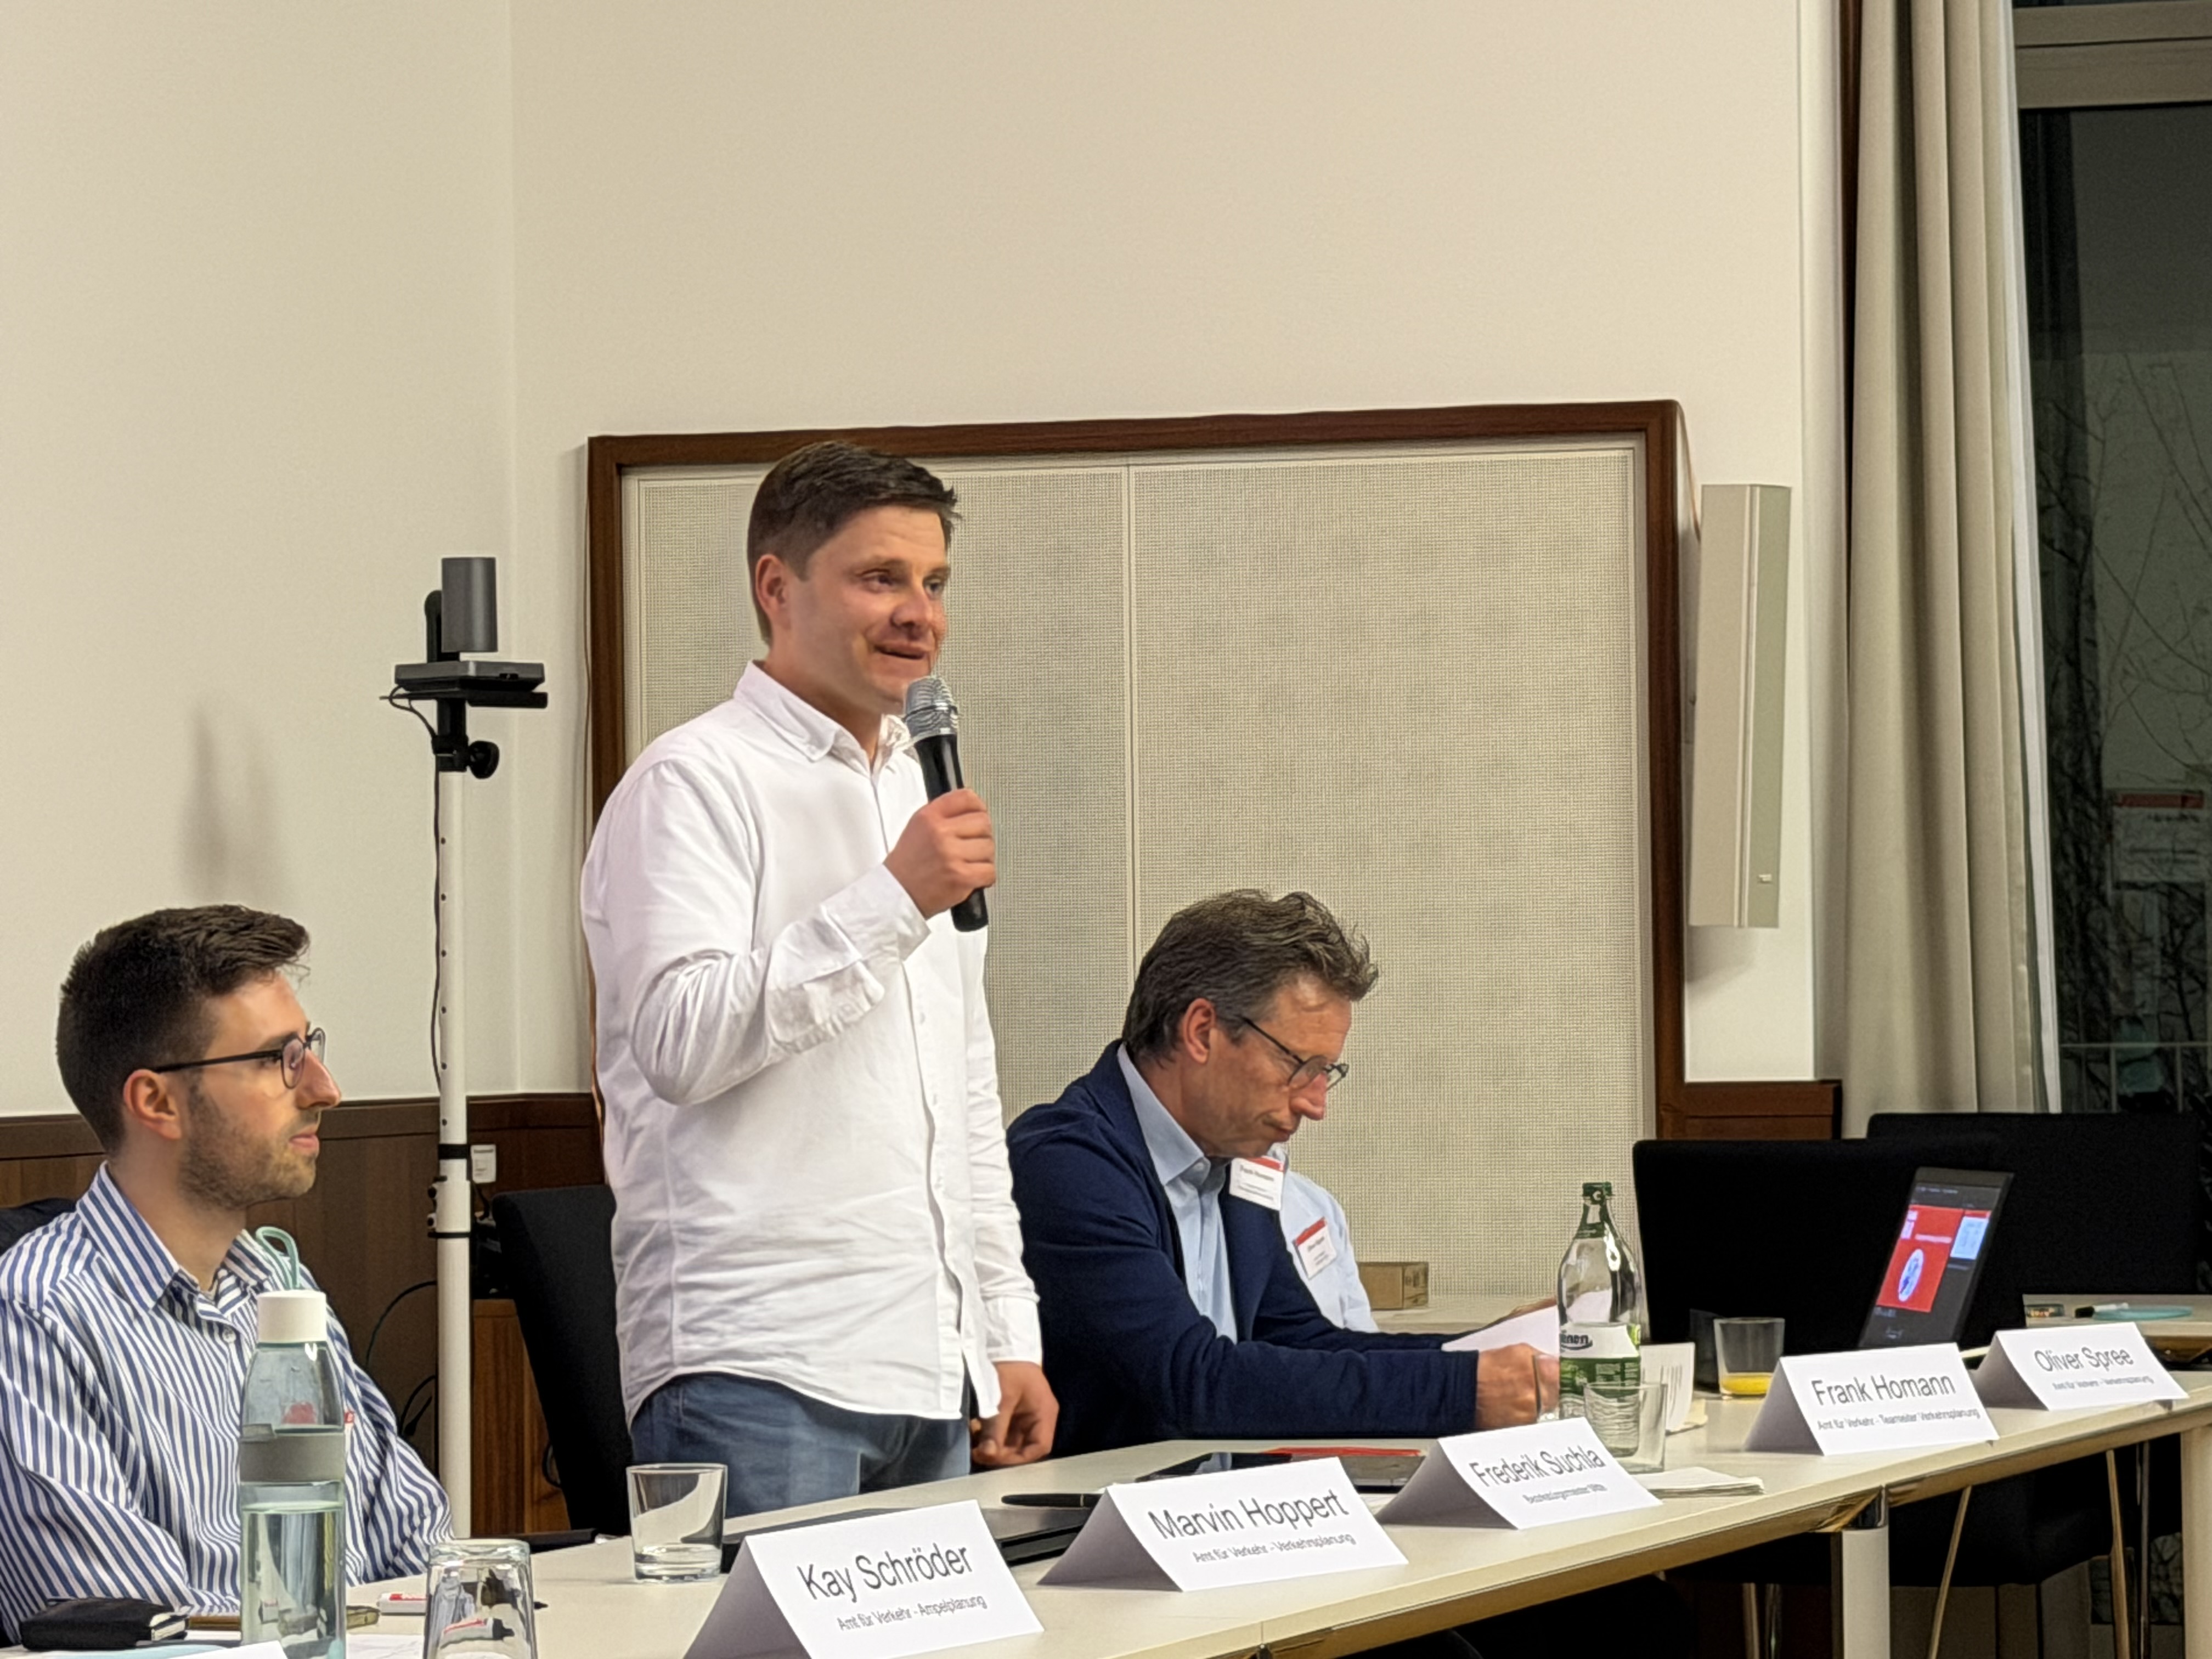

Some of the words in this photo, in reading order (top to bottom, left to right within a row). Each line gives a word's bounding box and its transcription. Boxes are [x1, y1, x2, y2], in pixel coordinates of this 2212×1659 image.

[2034, 1350, 2084, 1372] Oliver
[2081, 1346, 2134, 1372] Spree
[1811, 1376, 1873, 1406] Frank
[1871, 1374, 1956, 1401] Homann
[1469, 1453, 1549, 1487] Frederik
[1539, 1444, 1606, 1475] Suchla
[1148, 1503, 1244, 1539] Marvin
[1238, 1488, 1350, 1530] Hoppert
[1193, 1551, 1216, 1563] Amt
[1227, 1543, 1268, 1558] Verkehr
[797, 1564, 857, 1603] Kay
[855, 1543, 972, 1589] Schröder
[837, 1617, 861, 1631] Amt
[857, 1613, 874, 1627] für
[872, 1607, 912, 1624] Verkehr
[917, 1595, 988, 1616] Ampelplanung
